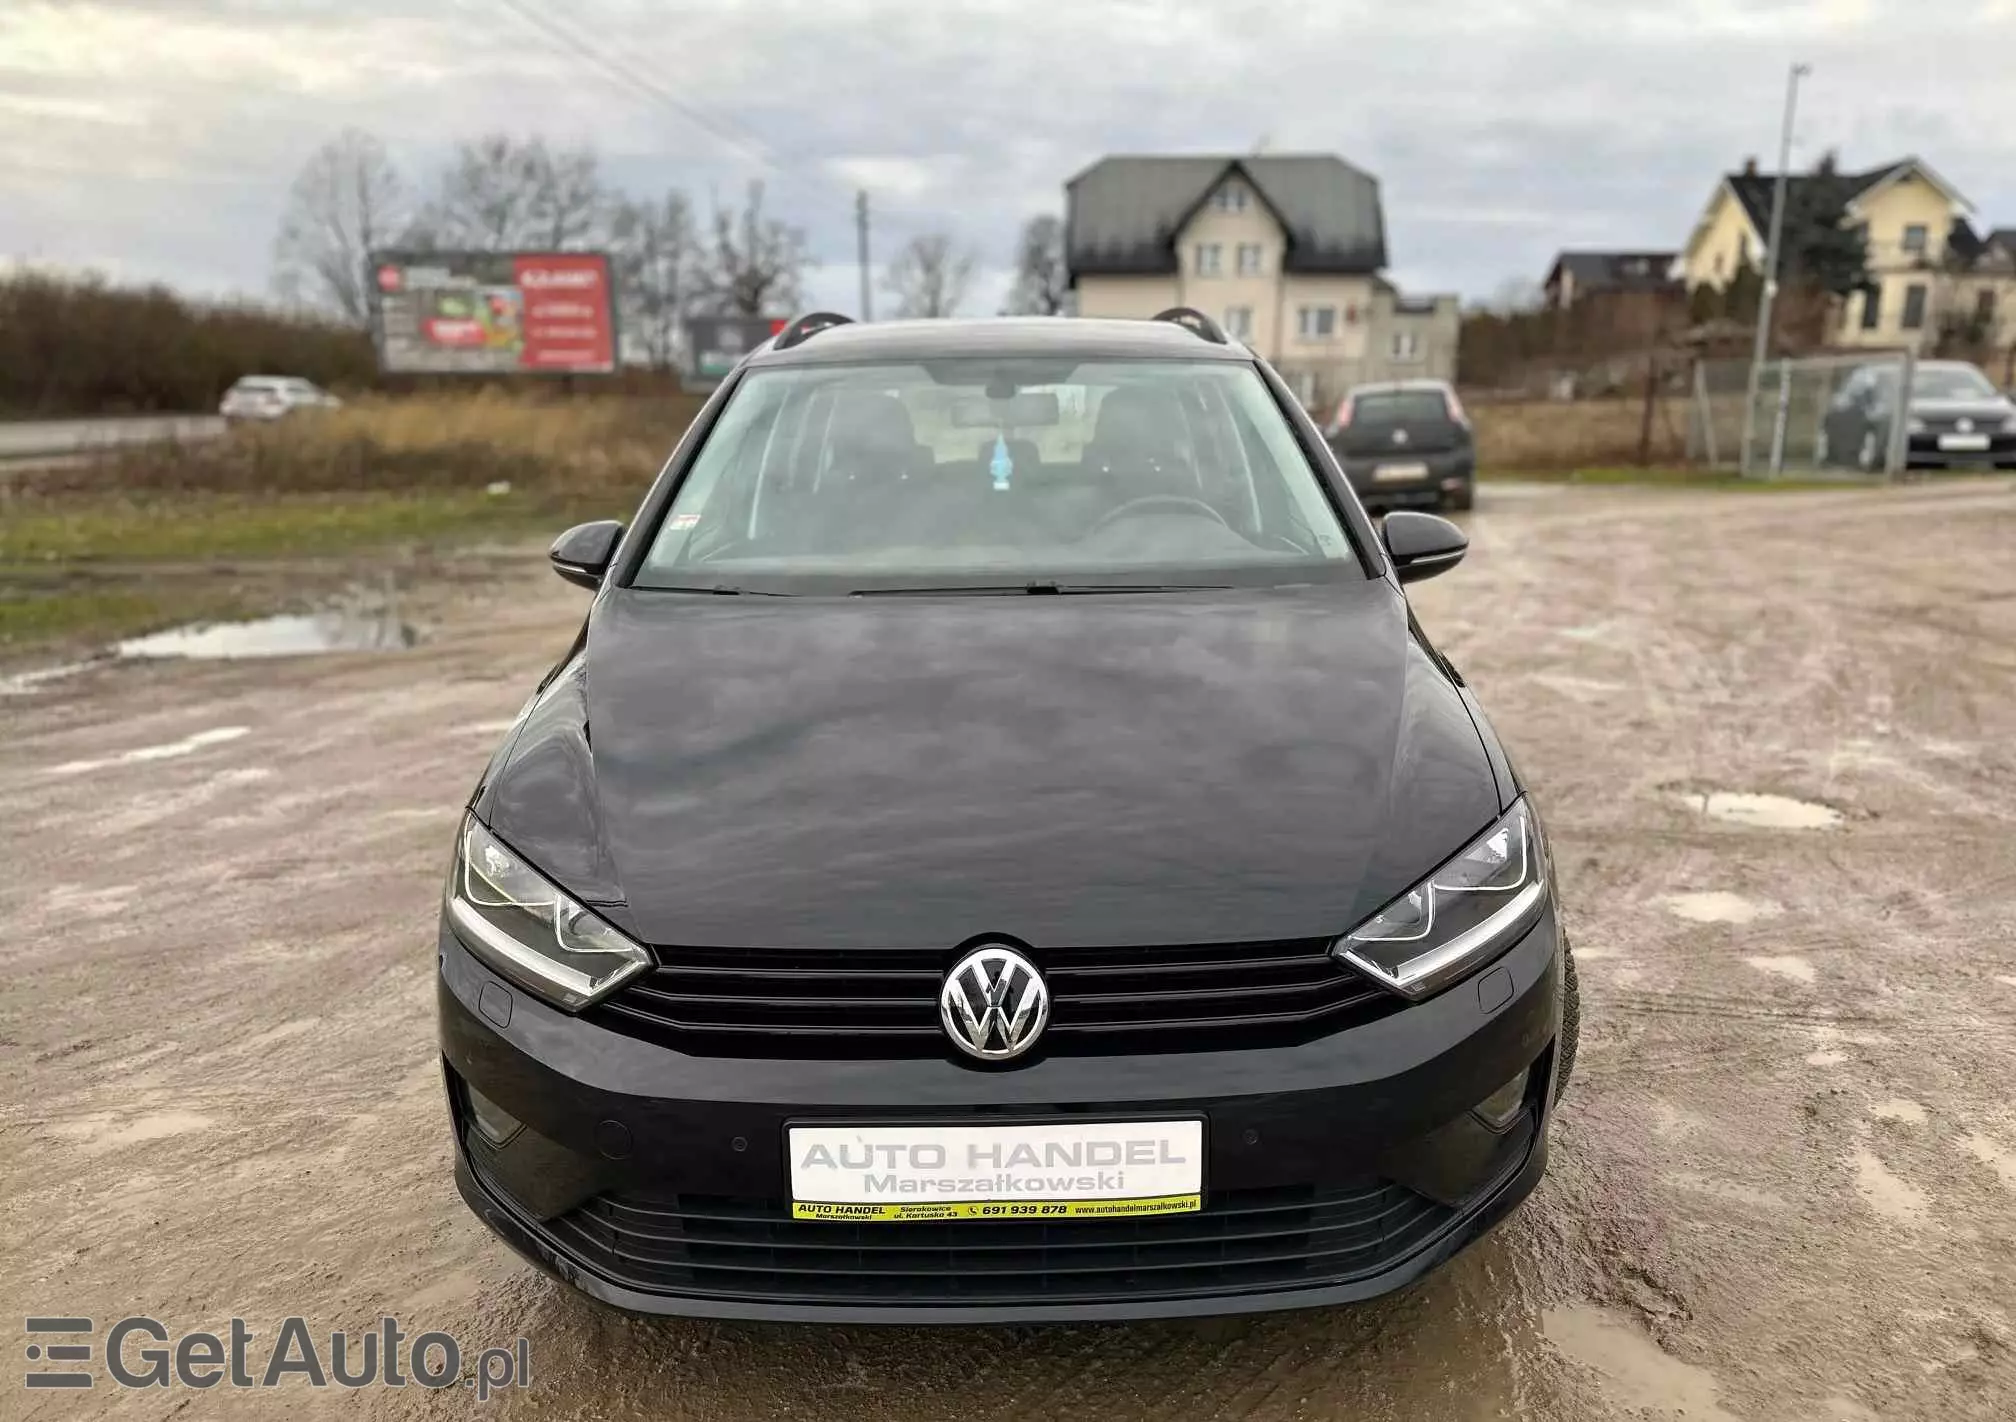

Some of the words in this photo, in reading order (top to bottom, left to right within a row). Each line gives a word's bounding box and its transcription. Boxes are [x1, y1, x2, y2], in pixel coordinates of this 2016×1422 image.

[942, 948, 1048, 1060] VW
[801, 1142, 946, 1170] AUTO
[968, 1139, 1187, 1169] HANDEL
[864, 1170, 1125, 1194] Marszałkowski
[799, 1204, 832, 1213] AUTO
[835, 1206, 886, 1215] HANDEL
[982, 1206, 1007, 1215] 691
[1010, 1206, 1037, 1215] 939
[1041, 1205, 1067, 1214] 878
